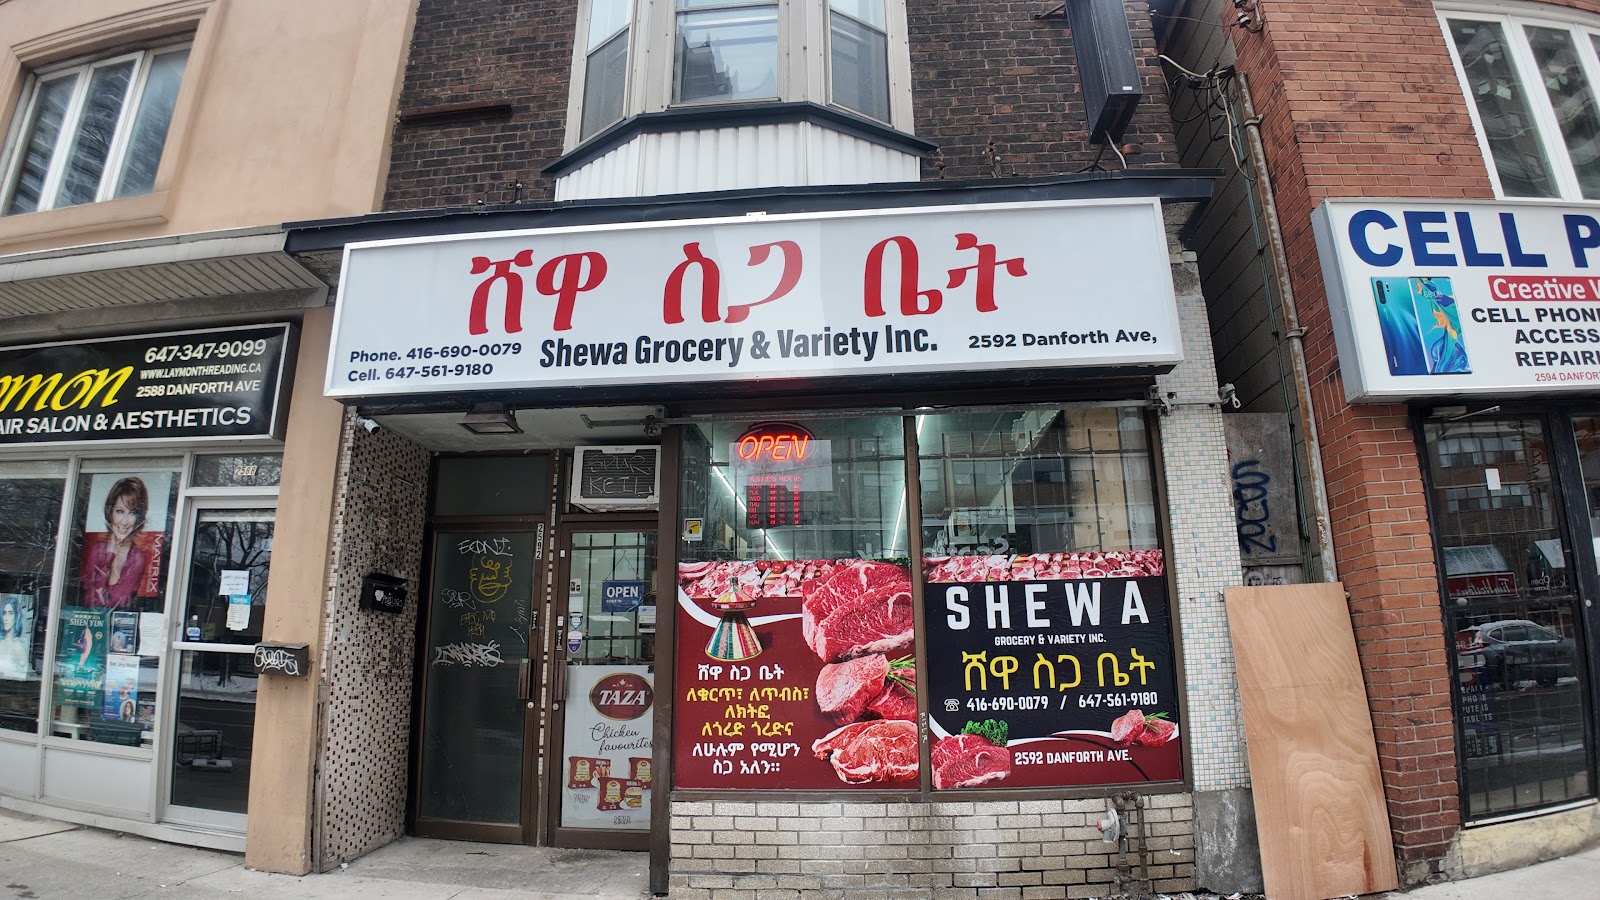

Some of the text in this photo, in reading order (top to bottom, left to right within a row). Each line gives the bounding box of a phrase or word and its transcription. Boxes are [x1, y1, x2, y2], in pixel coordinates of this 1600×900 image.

[1348, 209, 1600, 268] CELL P
[468, 232, 1028, 336] ሸዋ ስጋ ቤት
[1492, 277, 1586, 301] Creative
[1471, 308, 1600, 323] CELL PHON
[539, 324, 938, 368] Shewa Grocery & Variety Inc.
[968, 329, 1158, 349] 2592 Danforth Ave,
[144, 339, 267, 363] 647-347-9099
[350, 342, 522, 363] Phone. 416-690-0079
[139, 363, 262, 380] WWW.LAYMONTHREADING.CA
[347, 362, 493, 383] Cell. 647-561-9180
[1535, 370, 1600, 382] 2594 DANFOR
[136, 379, 262, 398] 2588 DANFORTH AVE
[25, 414, 91, 434] SALON
[93, 413, 108, 431] &
[110, 406, 252, 430] AESTHETICS
[738, 434, 809, 460] OPEN
[235, 465, 257, 477] 2588
[535, 523, 545, 559] 2592
[149, 533, 163, 593] MATRIX
[605, 586, 639, 598] OPEN
[945, 580, 1150, 630] SHEWA
[69, 618, 104, 627] SHEN YUN
[994, 633, 1107, 646] GROCERY & VARIETY INC.
[697, 663, 785, 681] ሸዋ ስጋ ቤት
[961, 647, 1156, 692] ሸዋ ስጋ ቤት
[598, 690, 647, 706] TAZA
[966, 696, 1049, 711] 416-690-0079
[1078, 692, 1158, 708] 647-561-9180
[1462, 713, 1493, 724] TABLTS
[589, 722, 640, 742] Chicken
[1014, 749, 1133, 765] 2592 DANFORTH AVE.
[712, 759, 733, 776] ስጋ
